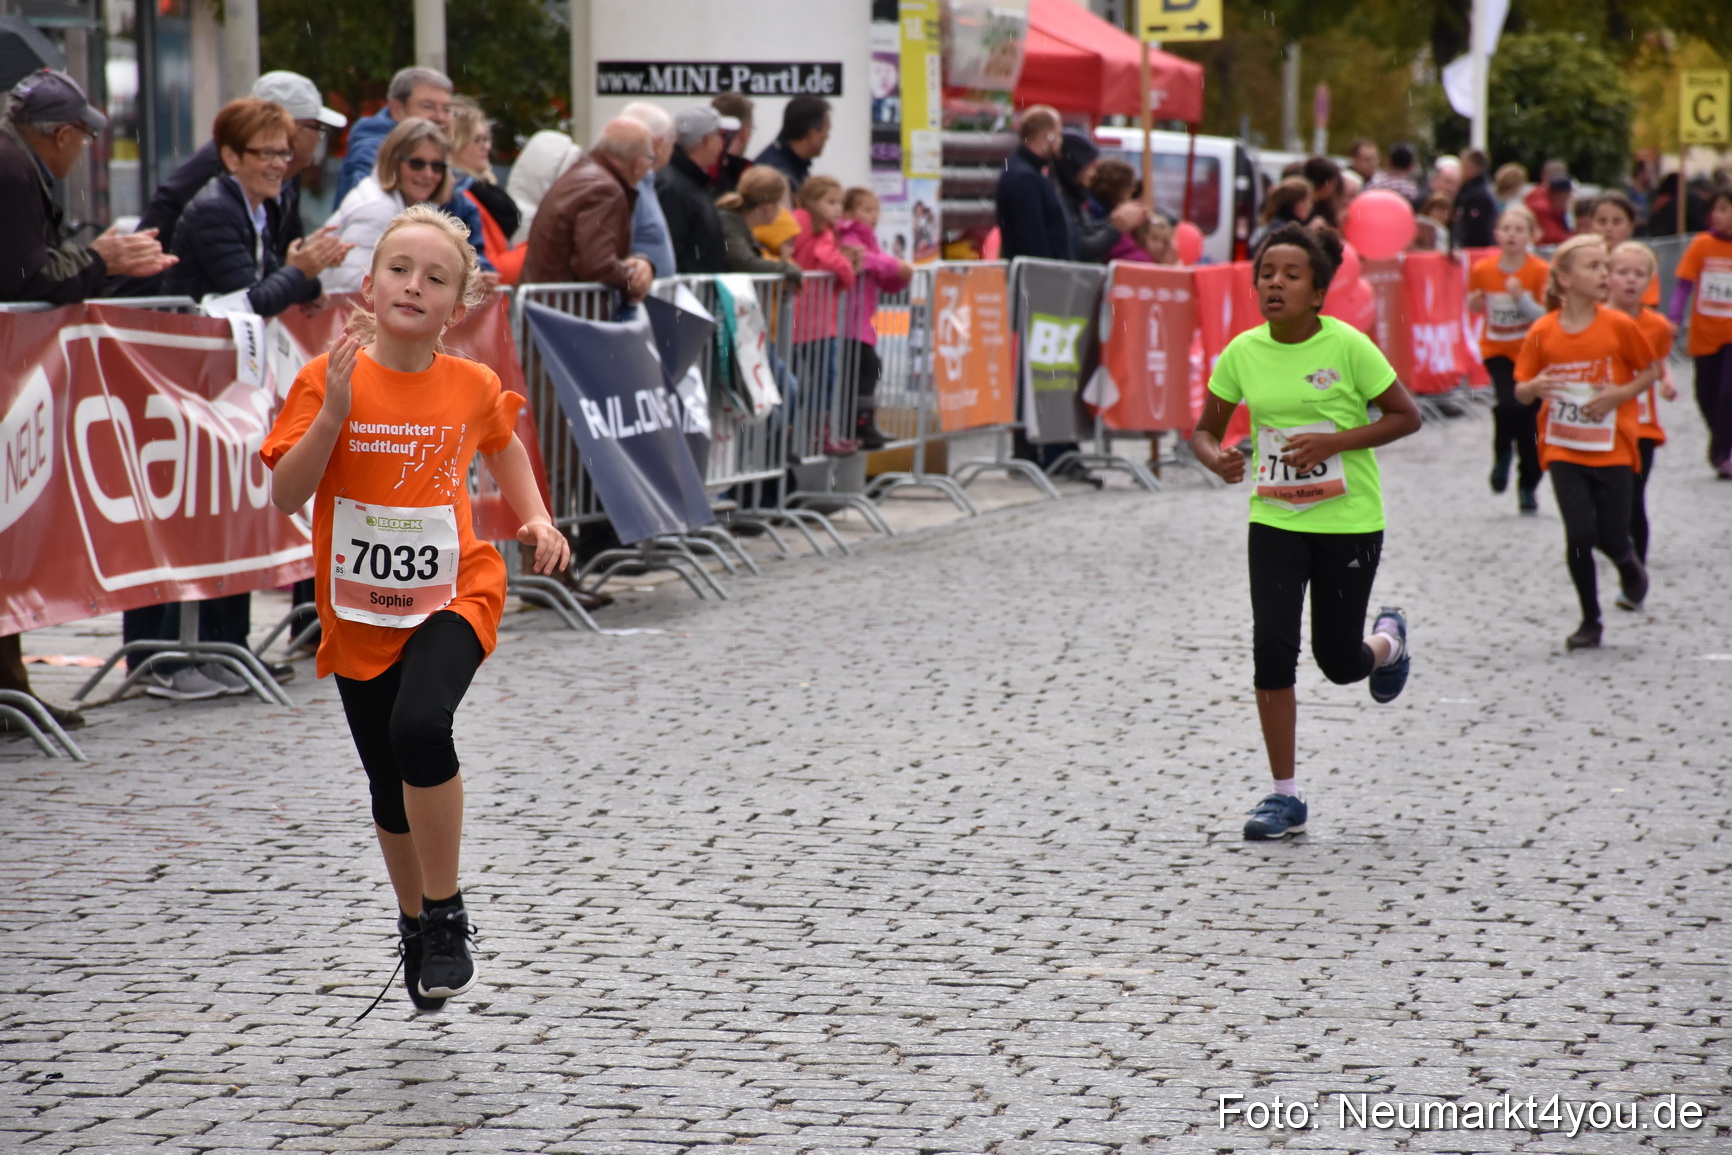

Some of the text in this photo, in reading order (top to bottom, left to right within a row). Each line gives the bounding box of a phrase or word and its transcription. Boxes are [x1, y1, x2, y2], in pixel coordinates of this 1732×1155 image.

[1691, 91, 1716, 127] C
[349, 421, 436, 436] Neumarkter
[5, 401, 46, 506] NEUE
[348, 439, 418, 457] Stadtlauf
[378, 517, 423, 530] BOCK
[351, 538, 439, 581] 7033
[370, 591, 414, 608] Sophie
